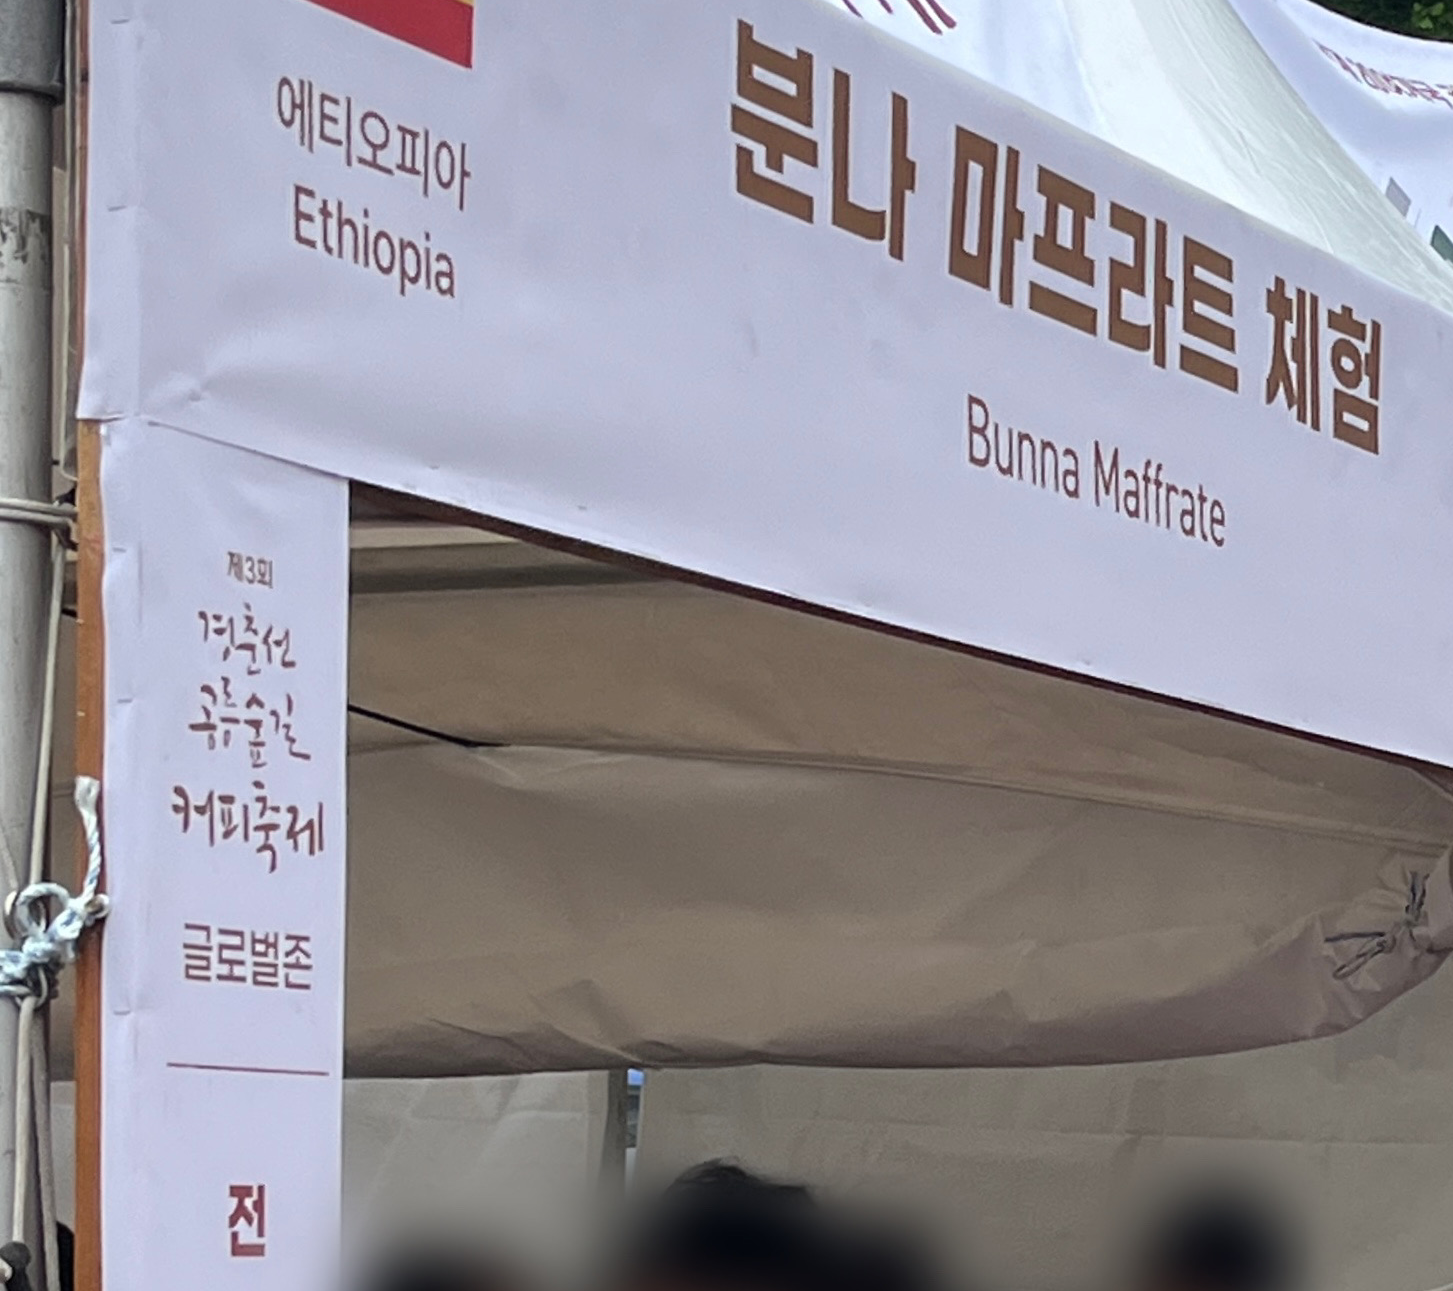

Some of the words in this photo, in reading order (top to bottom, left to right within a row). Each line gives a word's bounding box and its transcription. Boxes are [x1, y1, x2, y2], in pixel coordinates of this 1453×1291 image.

[276, 76, 471, 212] 에티오피아
[292, 183, 457, 298] Ethiopia
[731, 18, 915, 262] 분나
[947, 124, 1239, 395] 마프라트
[1265, 275, 1383, 456] 체험
[966, 393, 1081, 500] Bunna
[1093, 439, 1227, 548] Maffrate
[226, 550, 274, 590] 제3회
[198, 601, 297, 675] 경춘선
[188, 676, 311, 769] 공릉숲길
[171, 780, 325, 875] 커피축제
[182, 921, 313, 992] 글로벌존
[227, 1183, 267, 1259] 전
